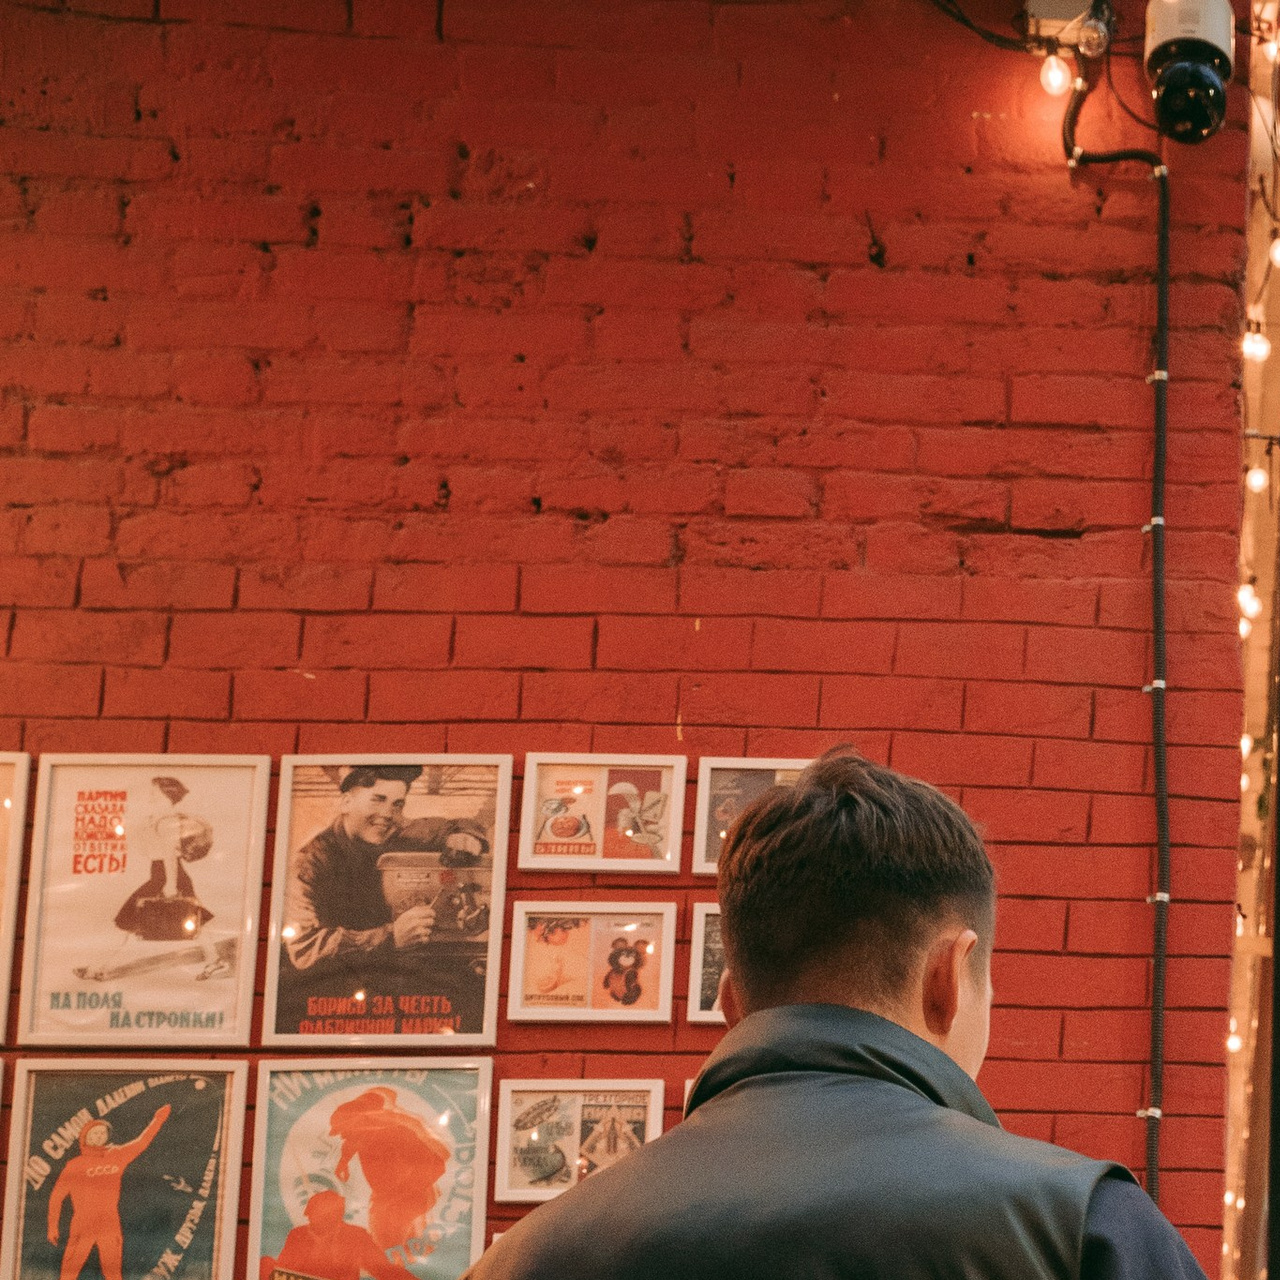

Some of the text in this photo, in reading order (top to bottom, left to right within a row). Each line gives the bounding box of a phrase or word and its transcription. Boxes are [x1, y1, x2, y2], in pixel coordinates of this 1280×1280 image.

[73, 853, 127, 874] ЕСТЬ!
[50, 991, 72, 1010] НА
[372, 996, 395, 1015] ЗА
[399, 995, 452, 1014] ЧЕСТЬ
[110, 1011, 133, 1028] НА
[85, 1164, 120, 1177] СССР
